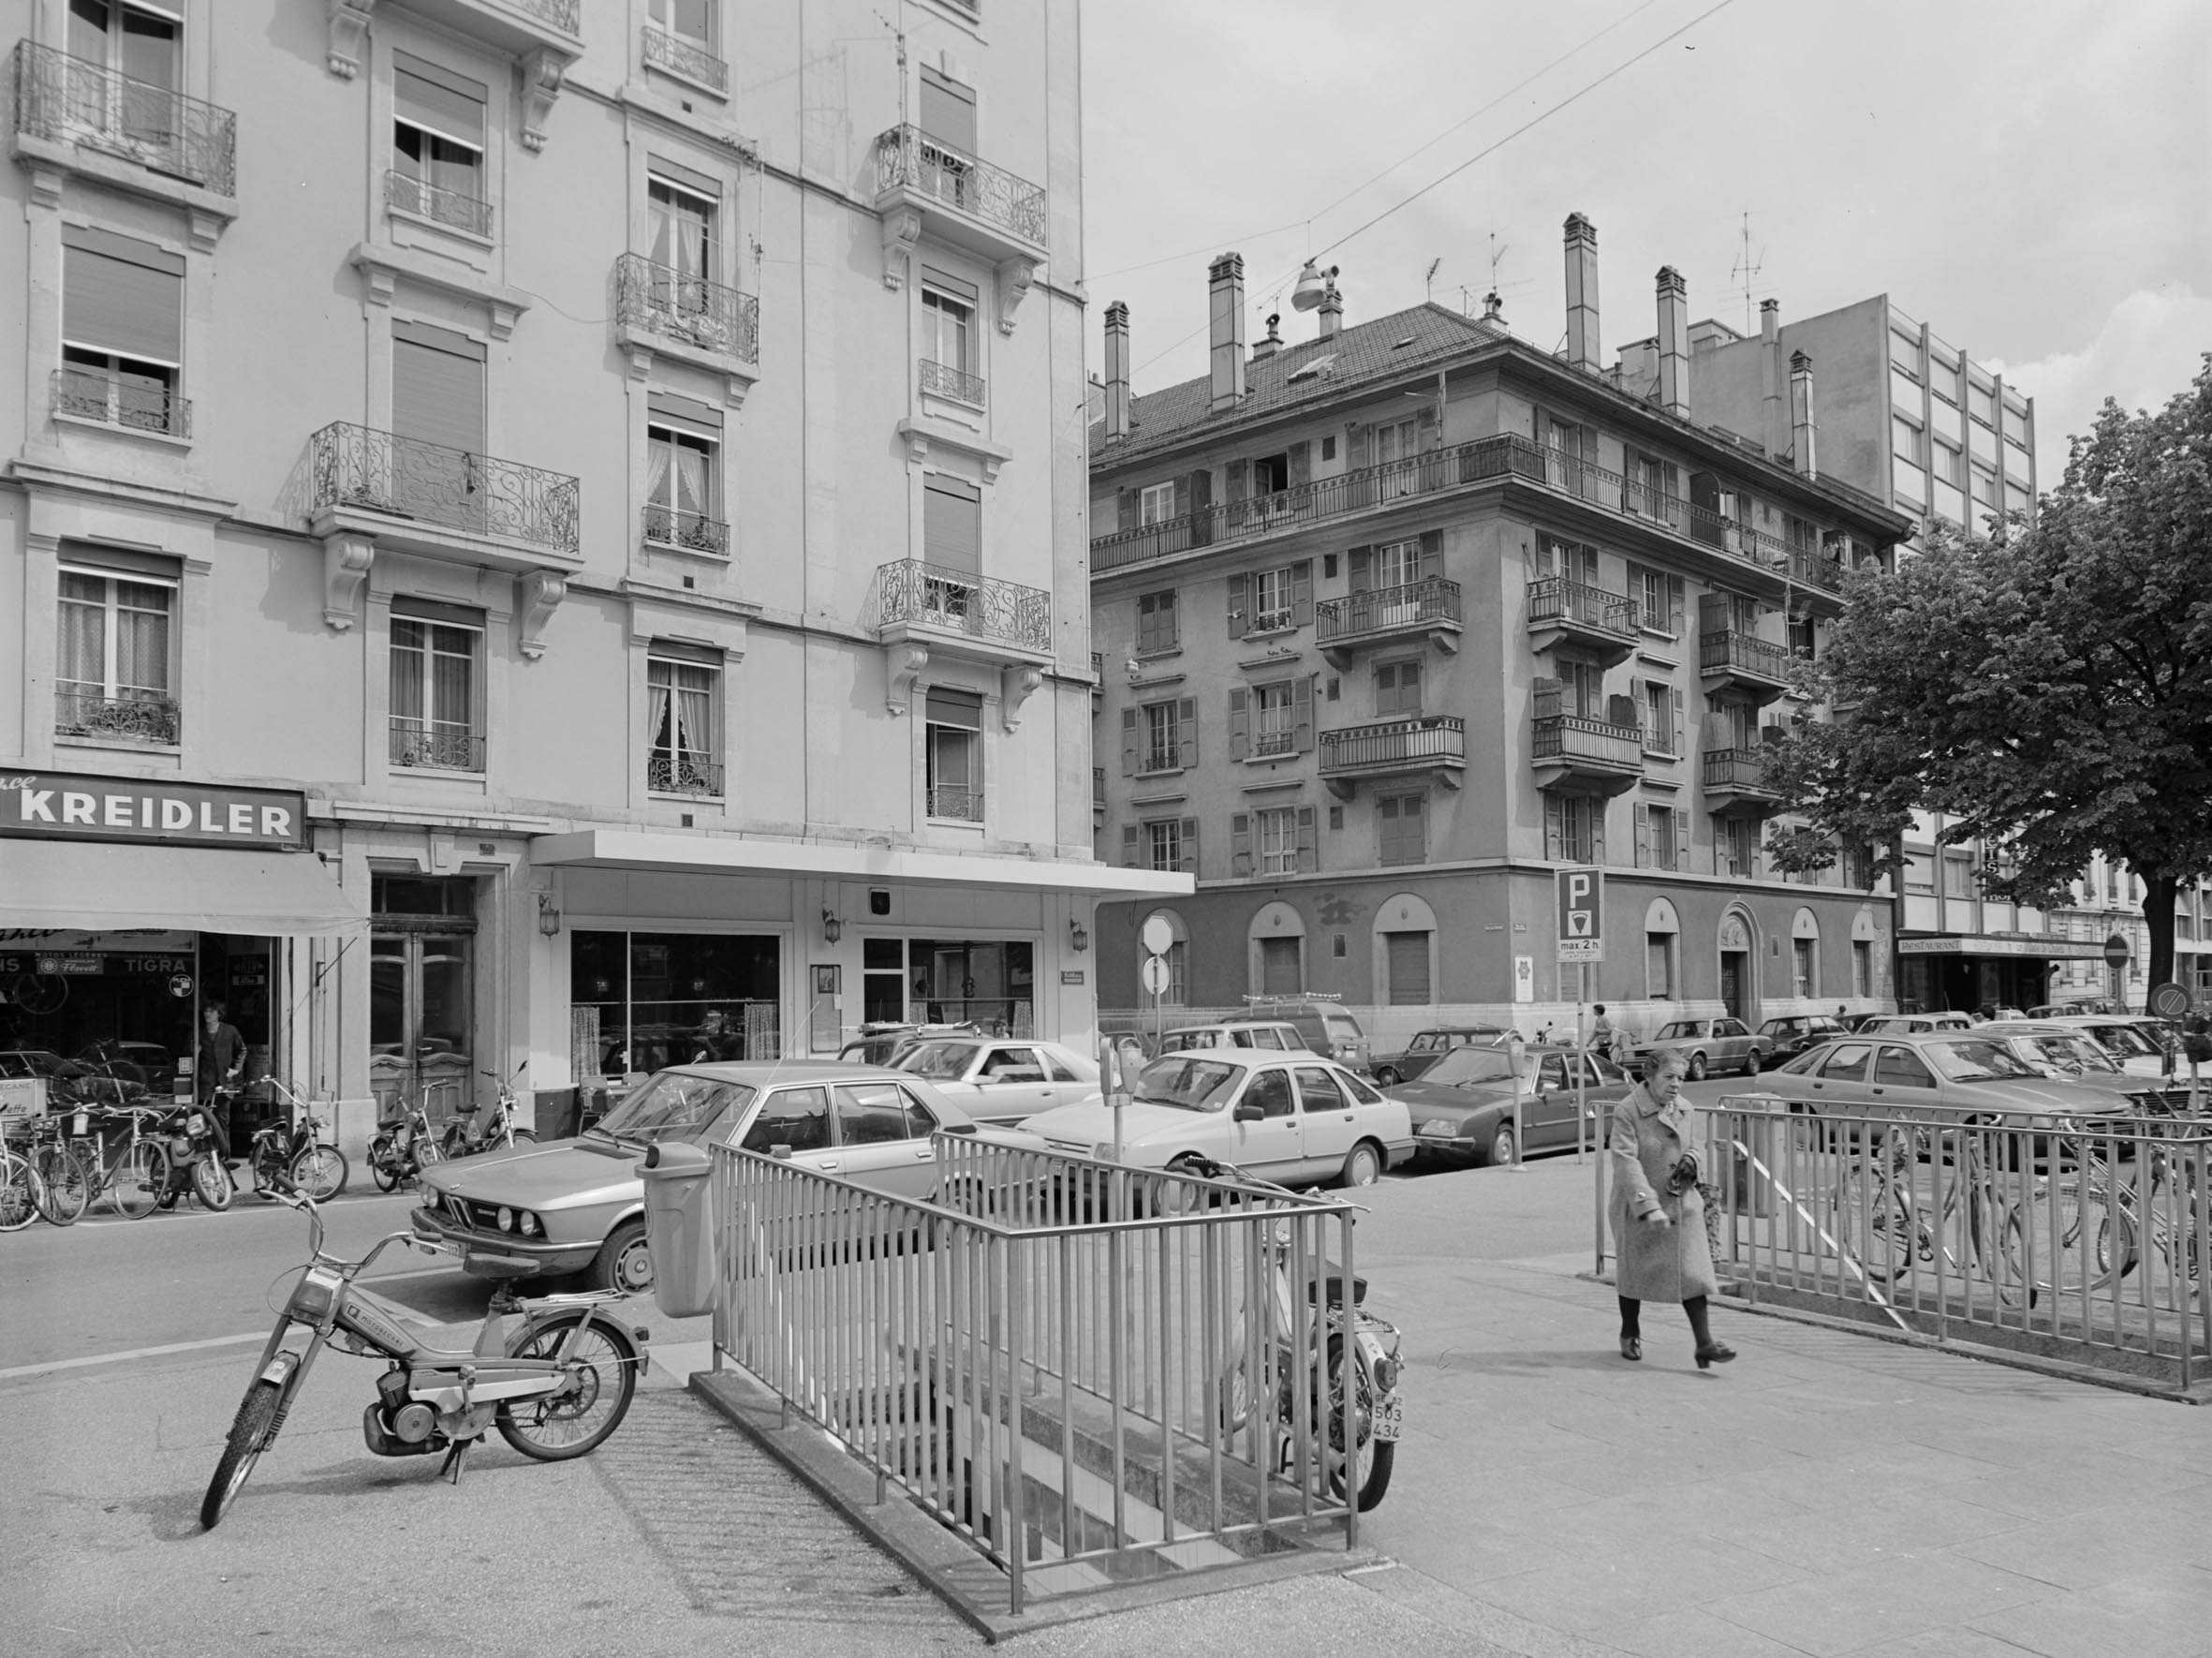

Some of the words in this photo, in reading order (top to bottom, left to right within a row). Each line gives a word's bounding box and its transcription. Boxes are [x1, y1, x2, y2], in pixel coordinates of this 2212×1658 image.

[21, 790, 291, 836] KREIDLER
[1570, 874, 1589, 909] P
[1583, 940, 1590, 950] 2
[1592, 940, 1599, 949] h
[124, 959, 186, 972] TIGRA
[1375, 1406, 1402, 1422] 503
[1373, 1424, 1400, 1438] 434
